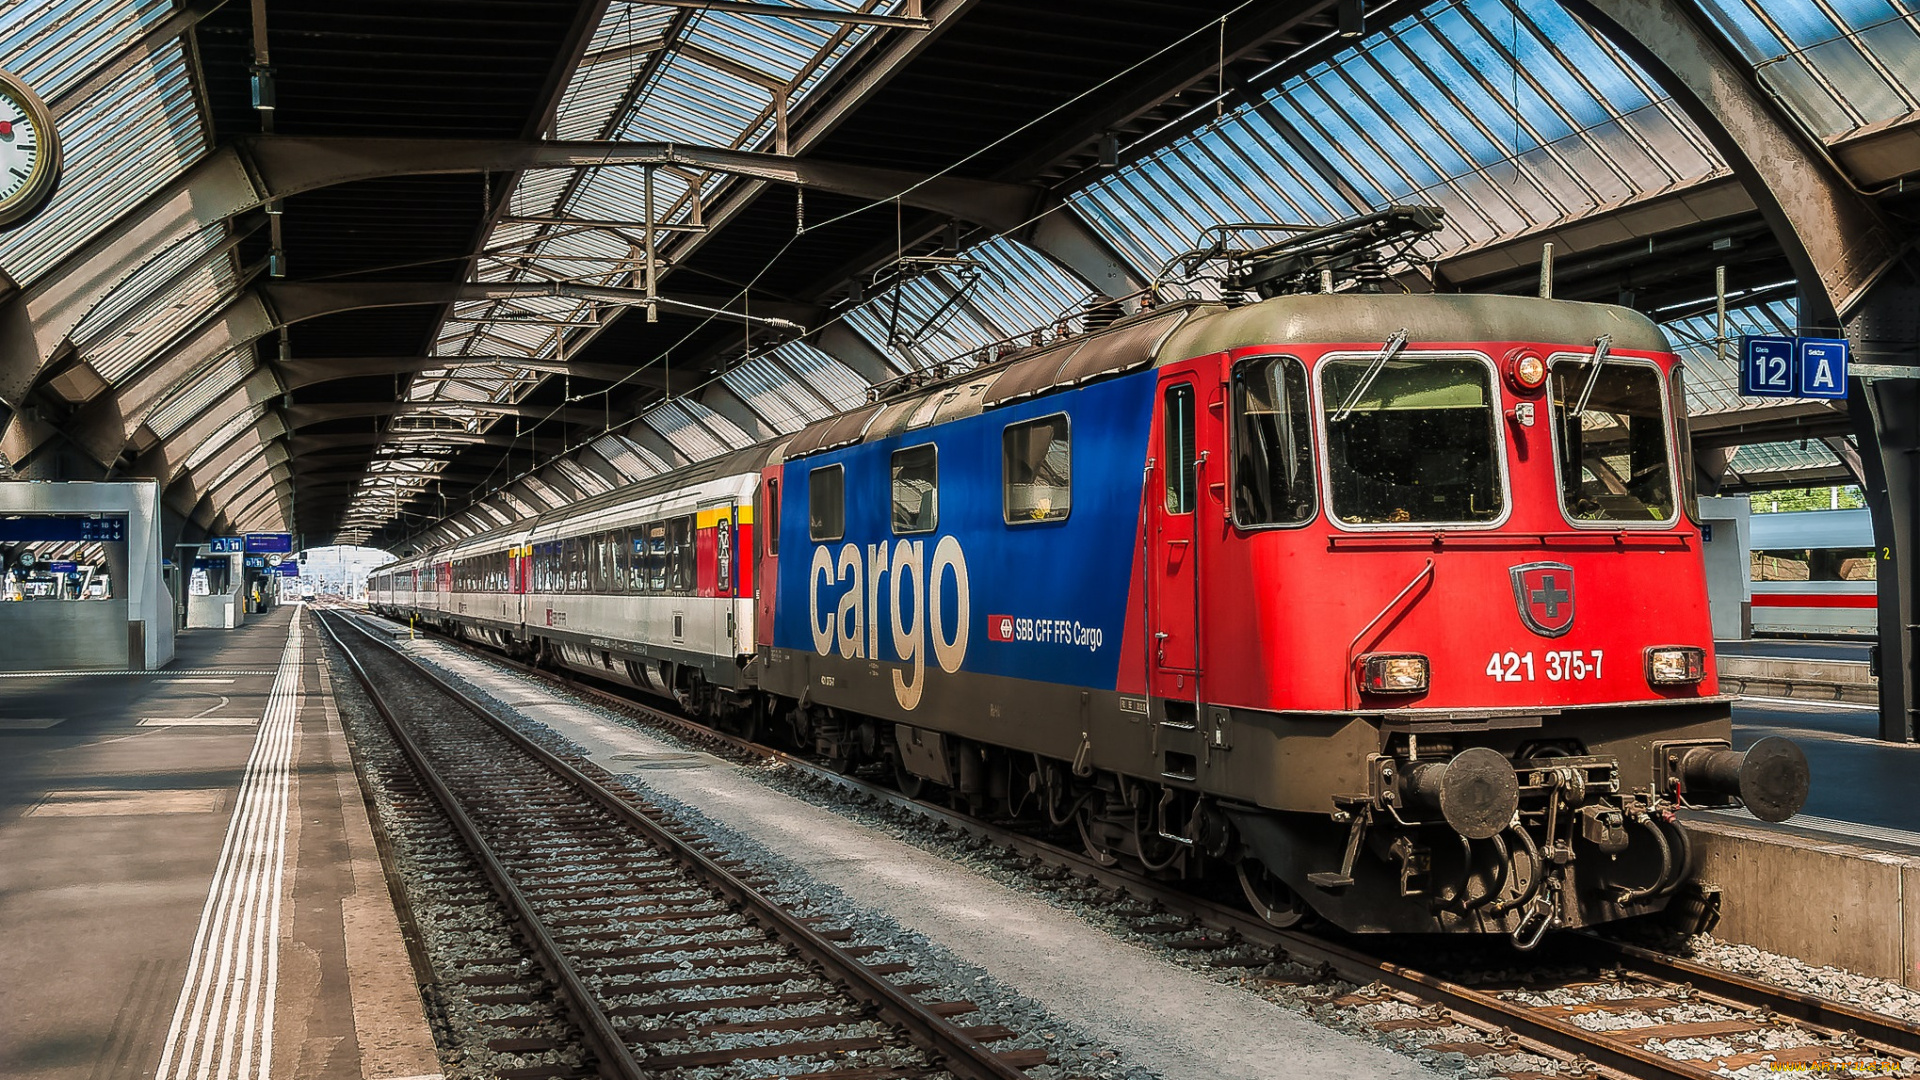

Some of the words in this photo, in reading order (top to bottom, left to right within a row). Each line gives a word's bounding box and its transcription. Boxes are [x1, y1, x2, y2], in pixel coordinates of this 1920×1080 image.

[1755, 356, 1787, 385] 12
[1812, 359, 1835, 388] A
[215, 542, 223, 550] A
[231, 542, 239, 550] 11
[1882, 547, 1890, 560] 2
[810, 535, 970, 711] cargo
[1016, 618, 1034, 641] SBB
[1035, 619, 1052, 642] CFF
[1054, 620, 1072, 644] FFS
[1073, 621, 1103, 652] Cargo
[1485, 651, 1535, 682] 421
[1545, 649, 1604, 681] 375-7
